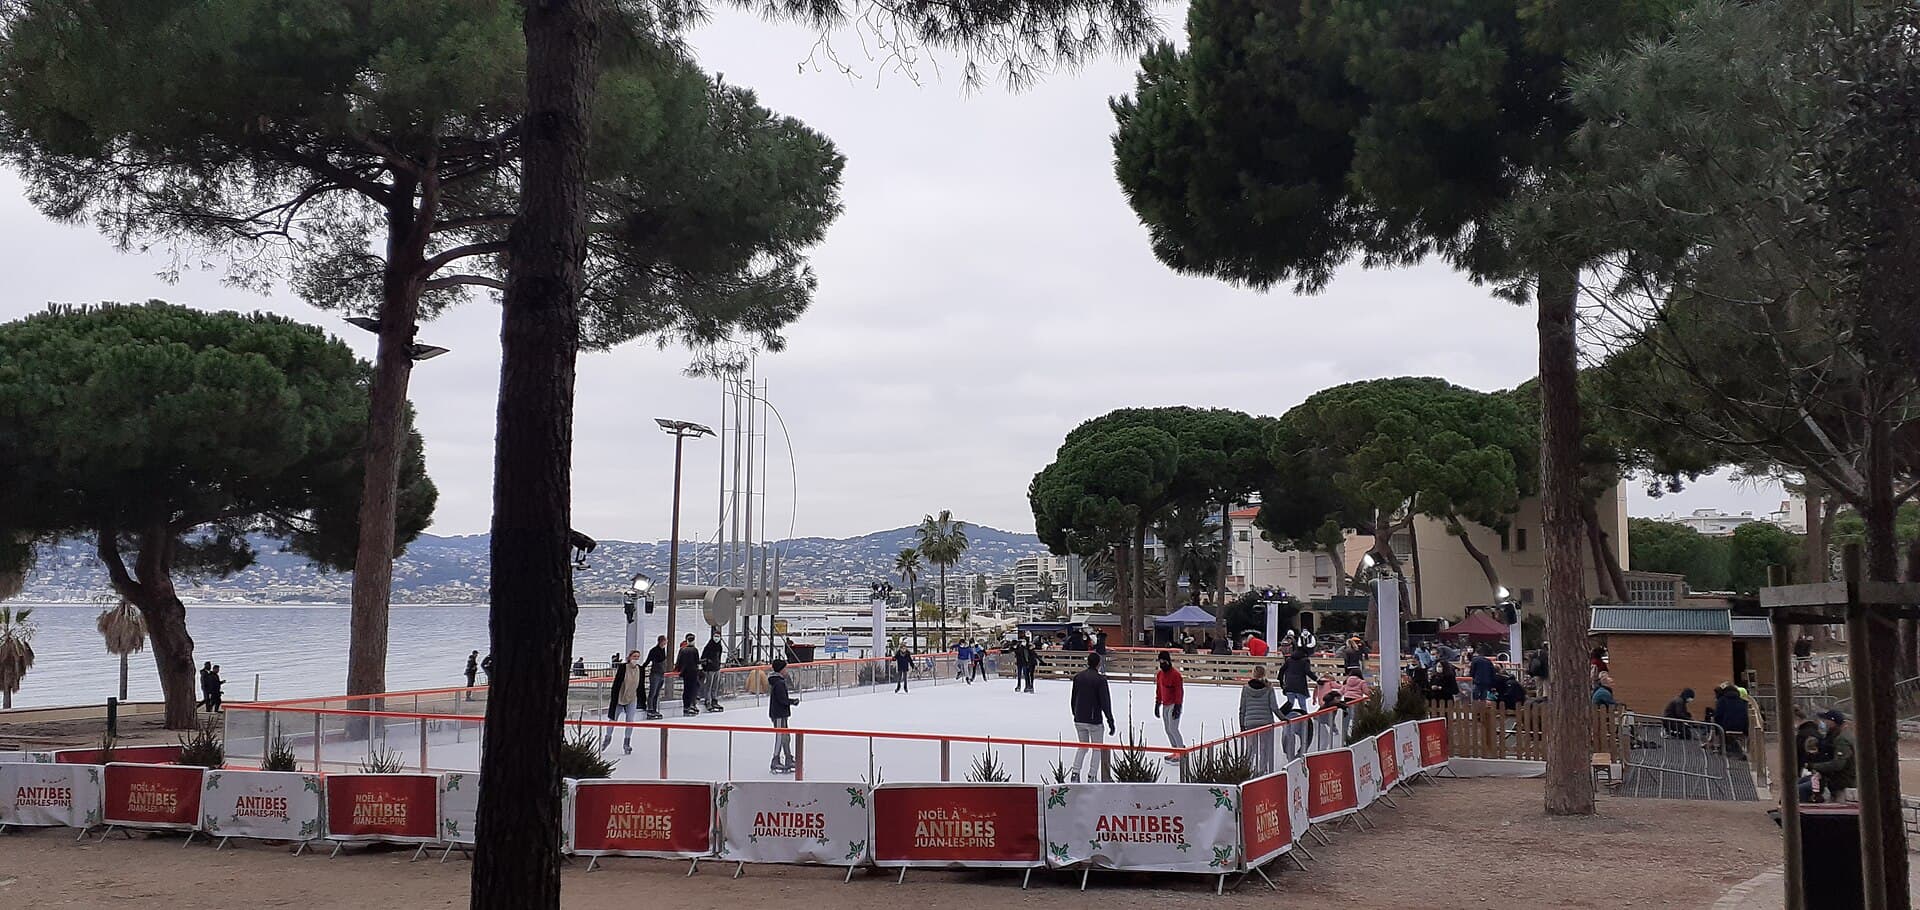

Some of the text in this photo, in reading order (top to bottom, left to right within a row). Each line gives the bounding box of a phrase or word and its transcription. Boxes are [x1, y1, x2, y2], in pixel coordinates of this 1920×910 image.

[17, 787, 71, 799] ANTIBES
[128, 792, 177, 806] ANTIBES
[355, 792, 375, 803] NOËL
[235, 796, 288, 810] ANTIBES
[610, 802, 635, 814] NOËL
[235, 809, 288, 818] JUAN-LES-PINS
[353, 803, 407, 817] ANTIBES
[918, 807, 960, 820] NOËL À
[606, 814, 672, 831] ANTIBES
[753, 812, 825, 829] ANTIBES
[1096, 815, 1185, 834] ANTIBES
[605, 829, 672, 840] JUAN-LES-PINS
[753, 827, 825, 839] JUAN-LES-PINS
[914, 820, 996, 838] ANTIBES
[914, 837, 996, 848] JUAN-LES-PINS
[1096, 832, 1186, 845] JUAN-LES-PINS
